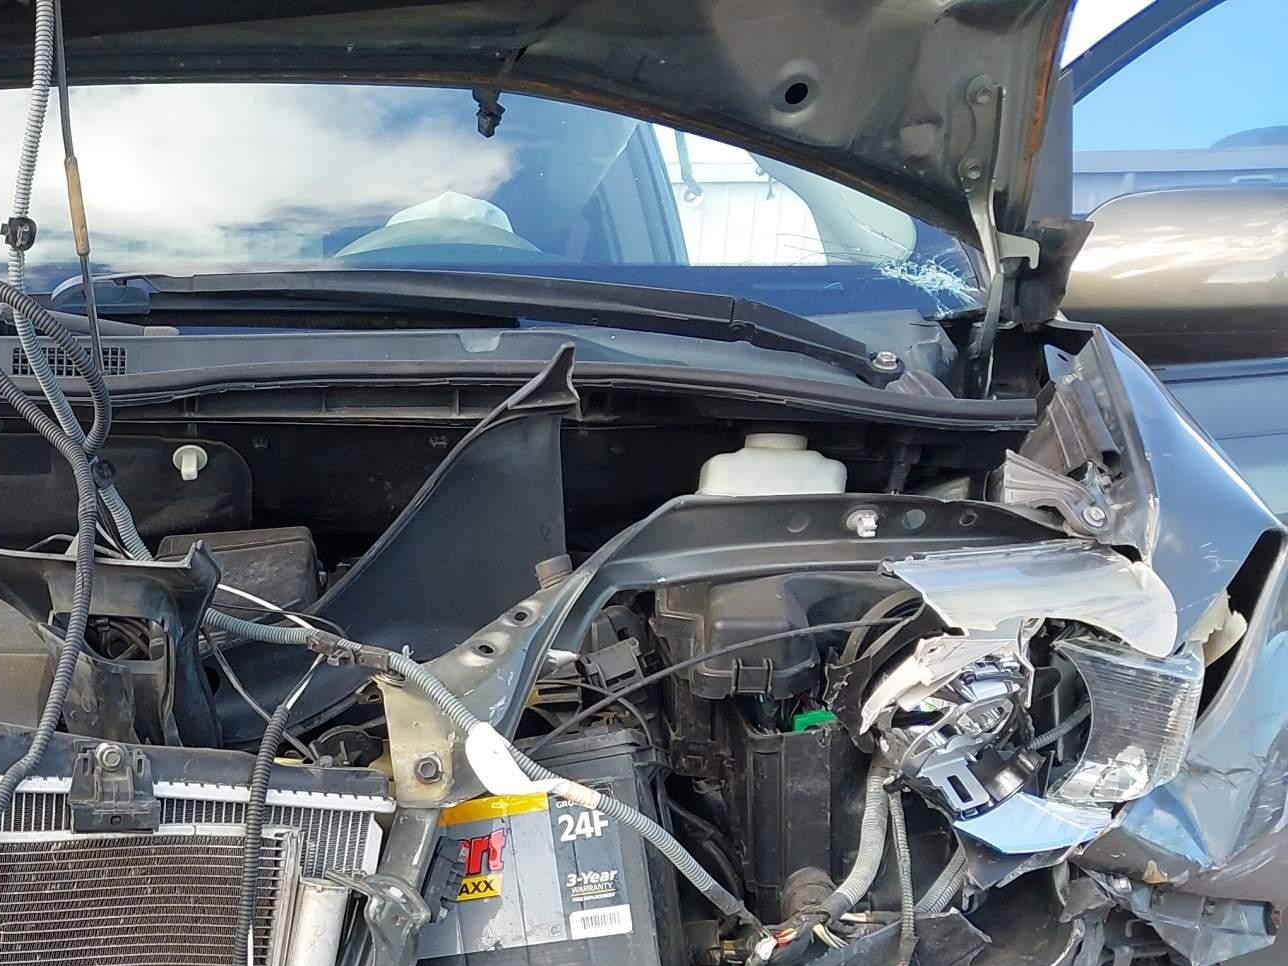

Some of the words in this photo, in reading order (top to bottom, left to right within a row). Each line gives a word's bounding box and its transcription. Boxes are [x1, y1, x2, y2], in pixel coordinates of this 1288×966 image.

[557, 809, 609, 842] 24F
[566, 869, 618, 887] 3-Year
[457, 879, 496, 896] AXX
[571, 881, 614, 894] WARRANTY
